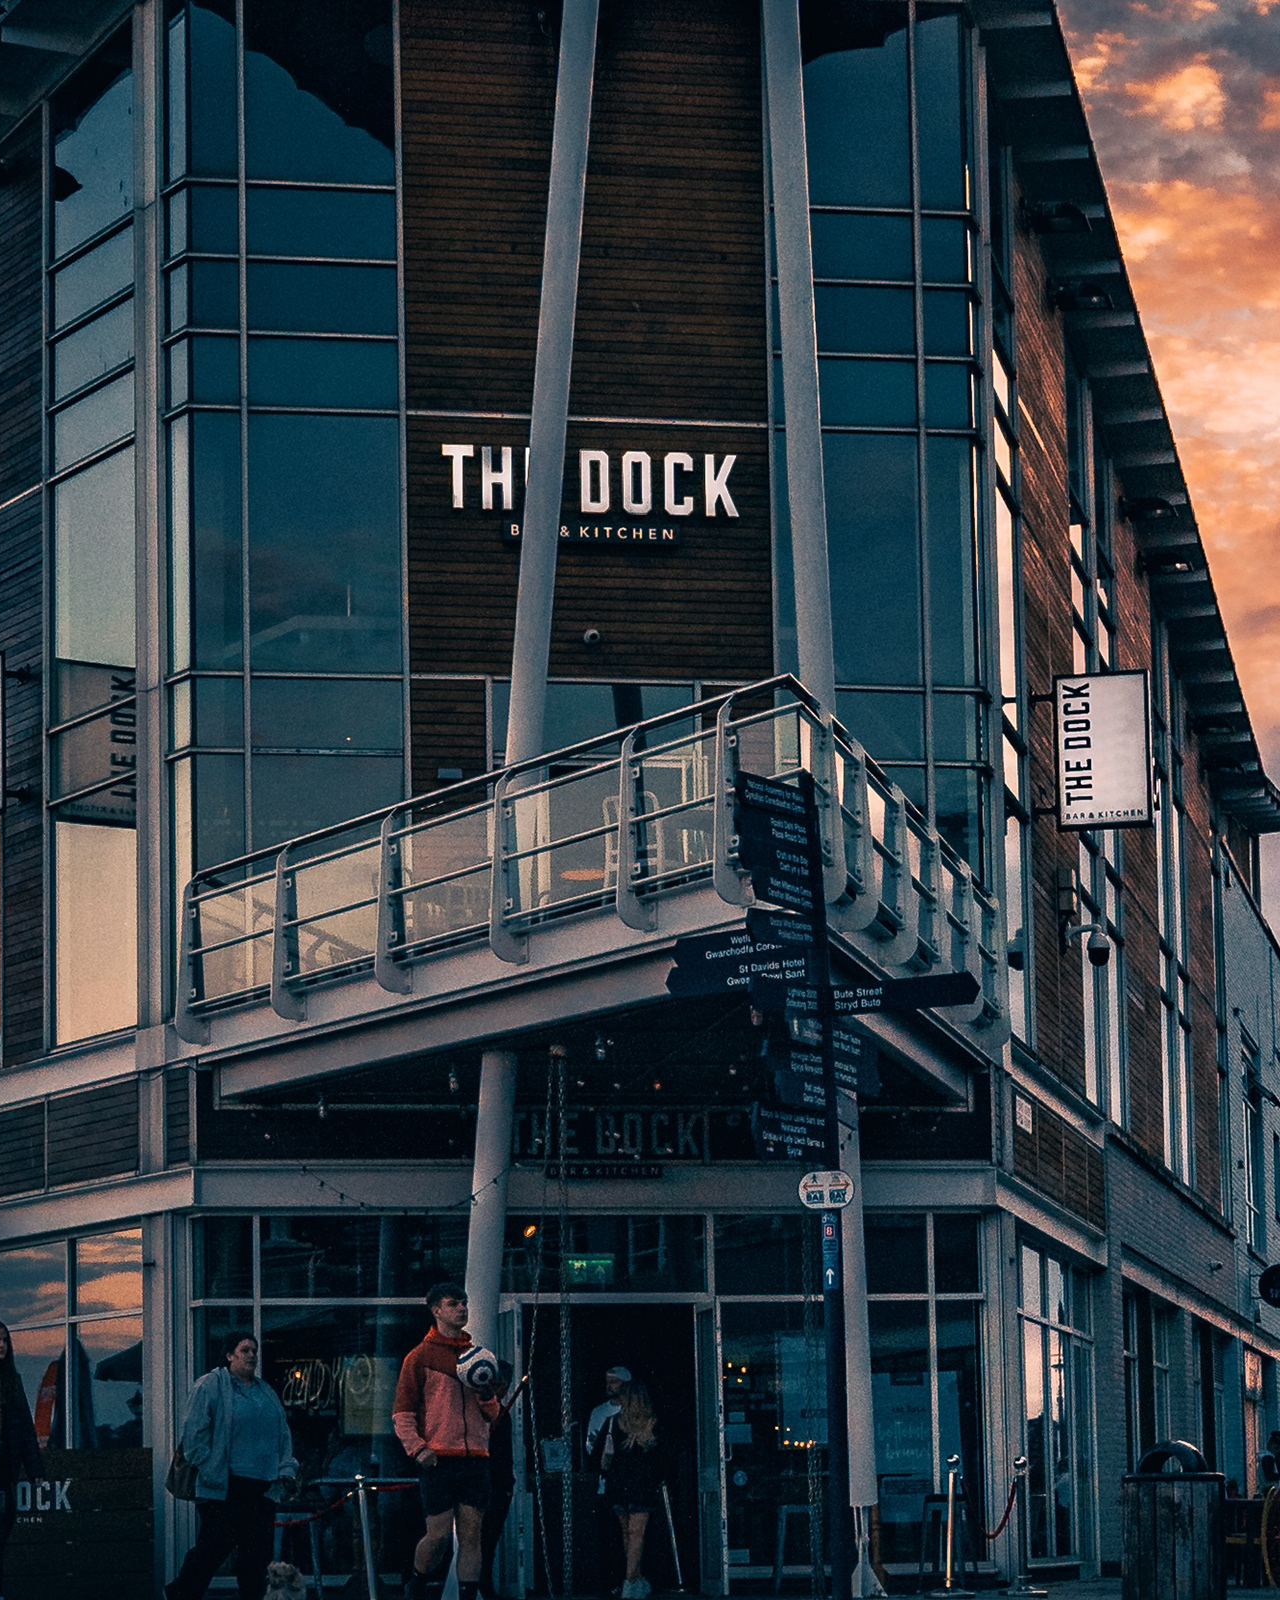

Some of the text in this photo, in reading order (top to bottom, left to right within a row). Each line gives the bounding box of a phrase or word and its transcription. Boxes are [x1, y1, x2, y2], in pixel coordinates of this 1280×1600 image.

[442, 444, 740, 518] TH DOCK
[580, 526, 674, 540] KITCHEN
[1063, 683, 1093, 806] THE DOCK
[1066, 812, 1085, 820] BAR
[1098, 809, 1144, 818] KITCHEN
[738, 958, 805, 974] St Davids Hotel
[785, 969, 805, 979] Sant
[834, 987, 882, 999] Bute Street
[834, 1001, 858, 1011] Stryd
[512, 1112, 699, 1155] THE DOCK
[596, 1167, 660, 1176] KITCHEN
[16, 1481, 71, 1511] OCK
[16, 1516, 43, 1524] CHEN
